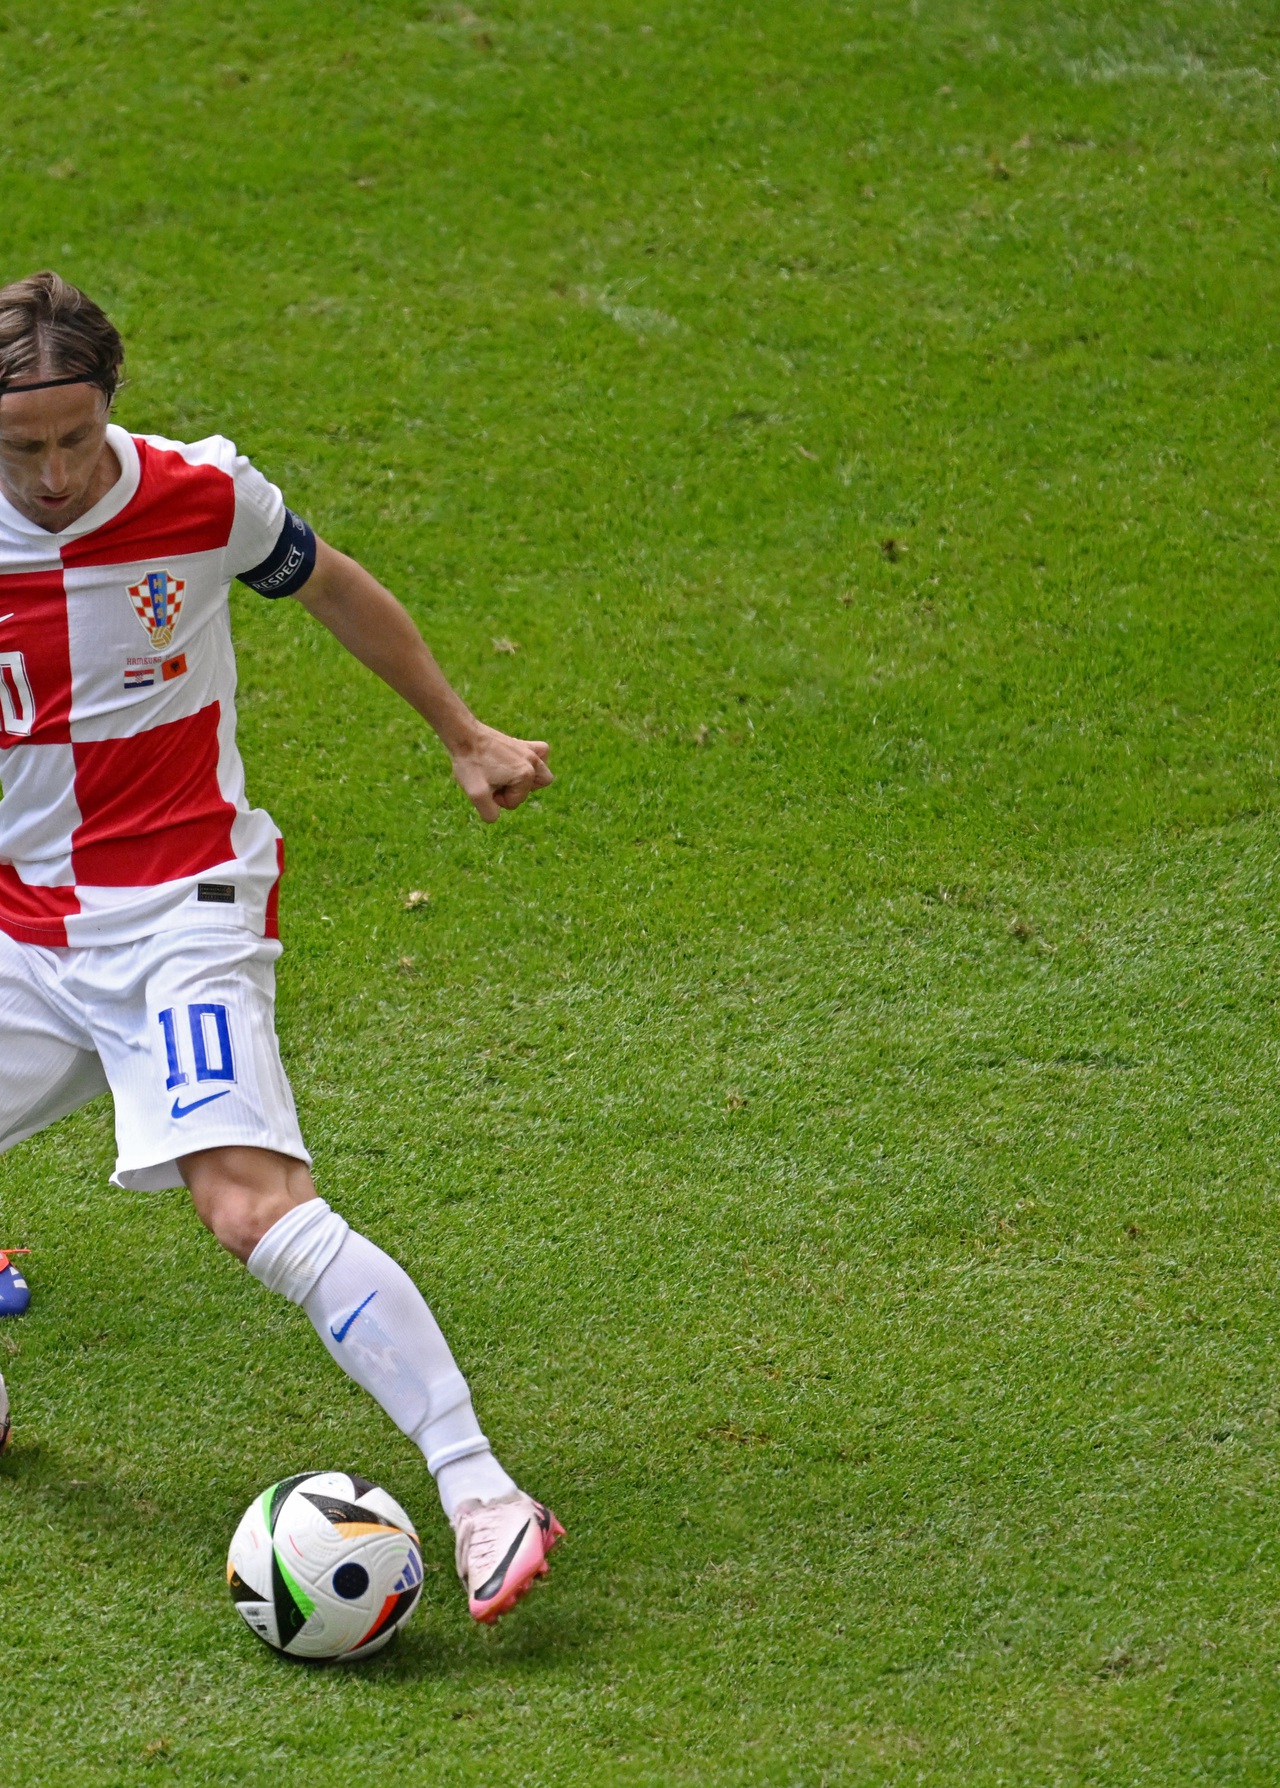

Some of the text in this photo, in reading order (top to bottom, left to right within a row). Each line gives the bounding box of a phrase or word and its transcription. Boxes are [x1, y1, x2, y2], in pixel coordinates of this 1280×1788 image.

[251, 545, 302, 591] RESPECT
[152, 578, 165, 620] HNS
[158, 1002, 239, 1093] 10
